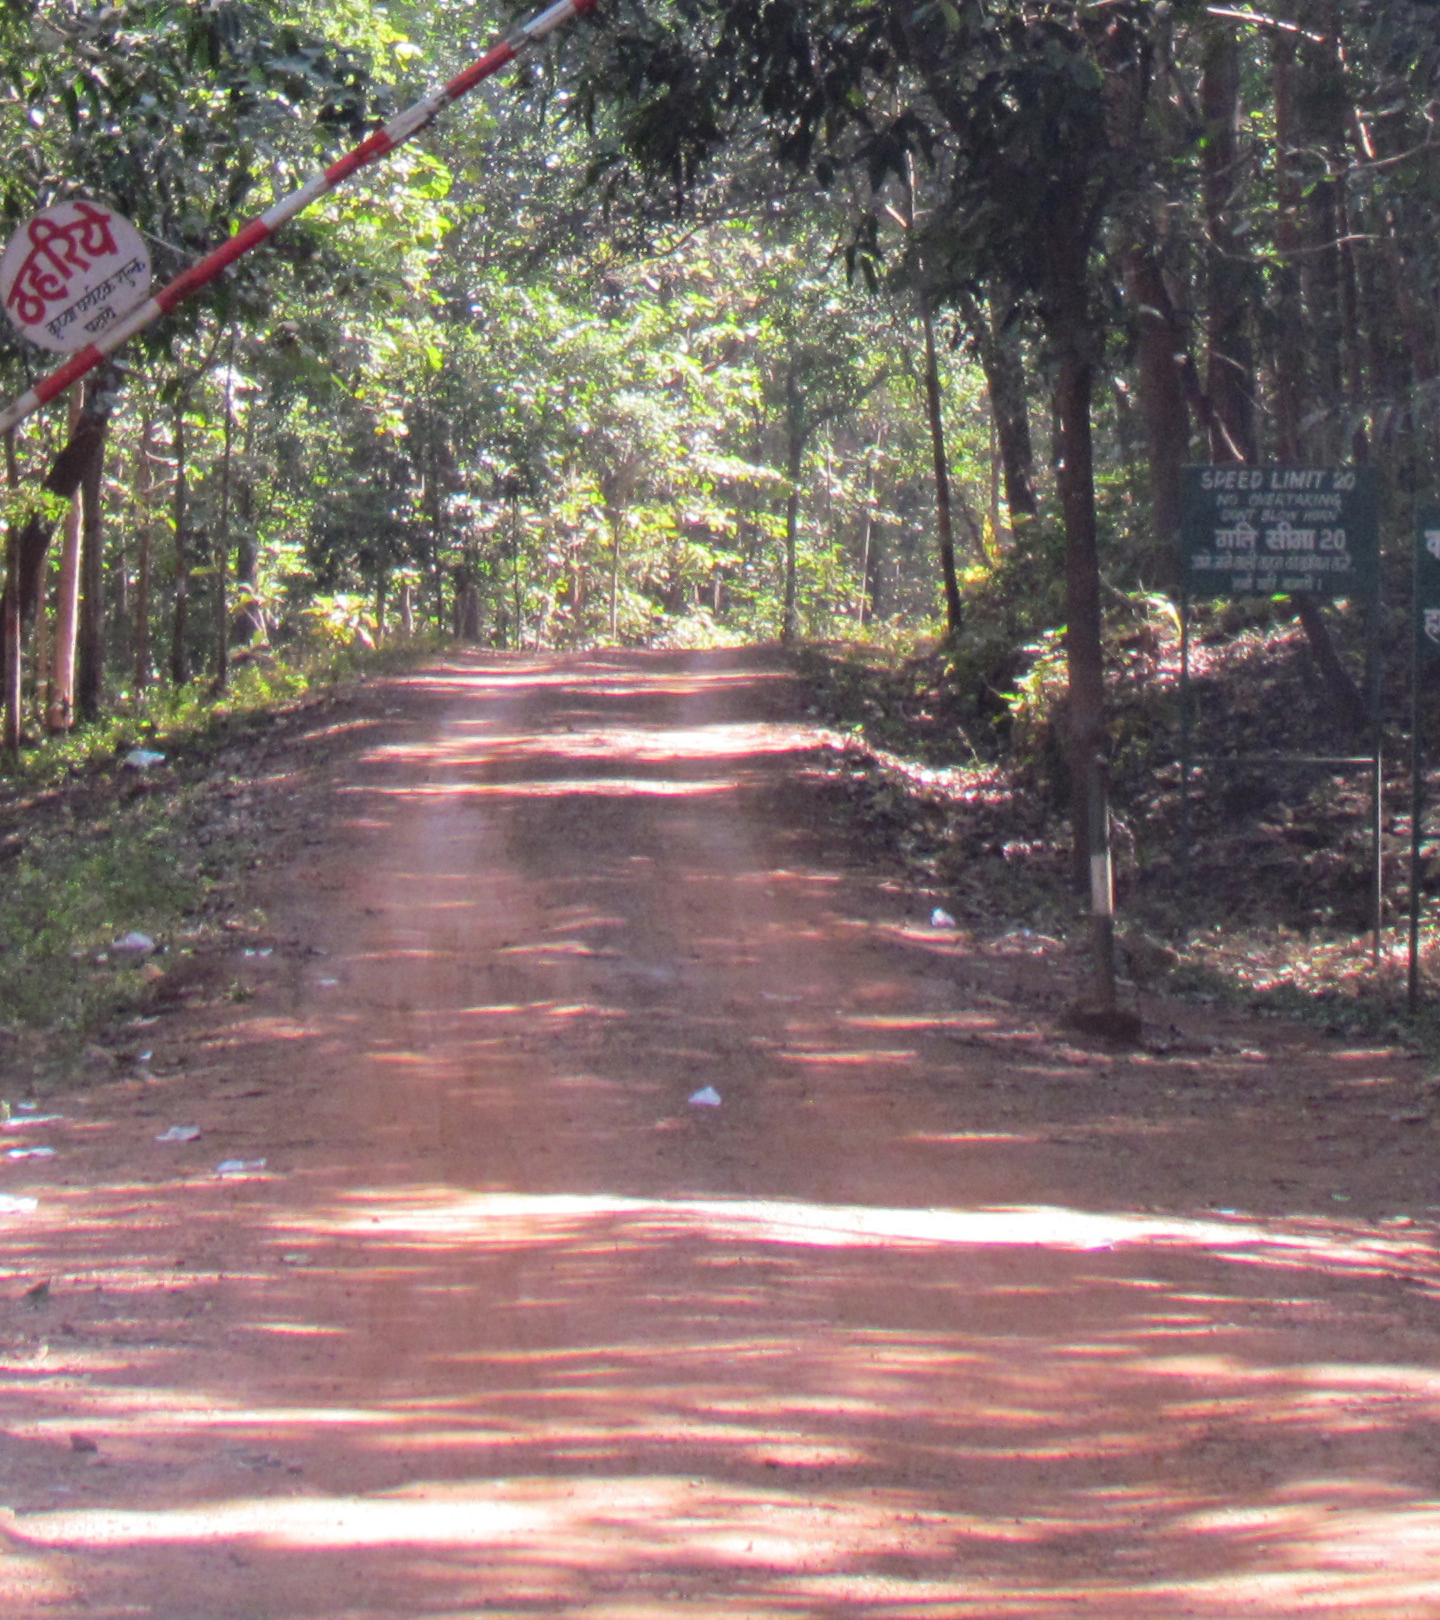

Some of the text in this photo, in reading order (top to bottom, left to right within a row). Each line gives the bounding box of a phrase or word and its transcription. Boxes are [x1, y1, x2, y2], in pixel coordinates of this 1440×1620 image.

[6, 202, 119, 325] ठहरिये
[1200, 470, 1357, 491] SPEED LIMIT 20
[1216, 493, 1239, 507] NO
[1265, 521, 1317, 550] सीमा
[1319, 529, 1347, 550] 20
